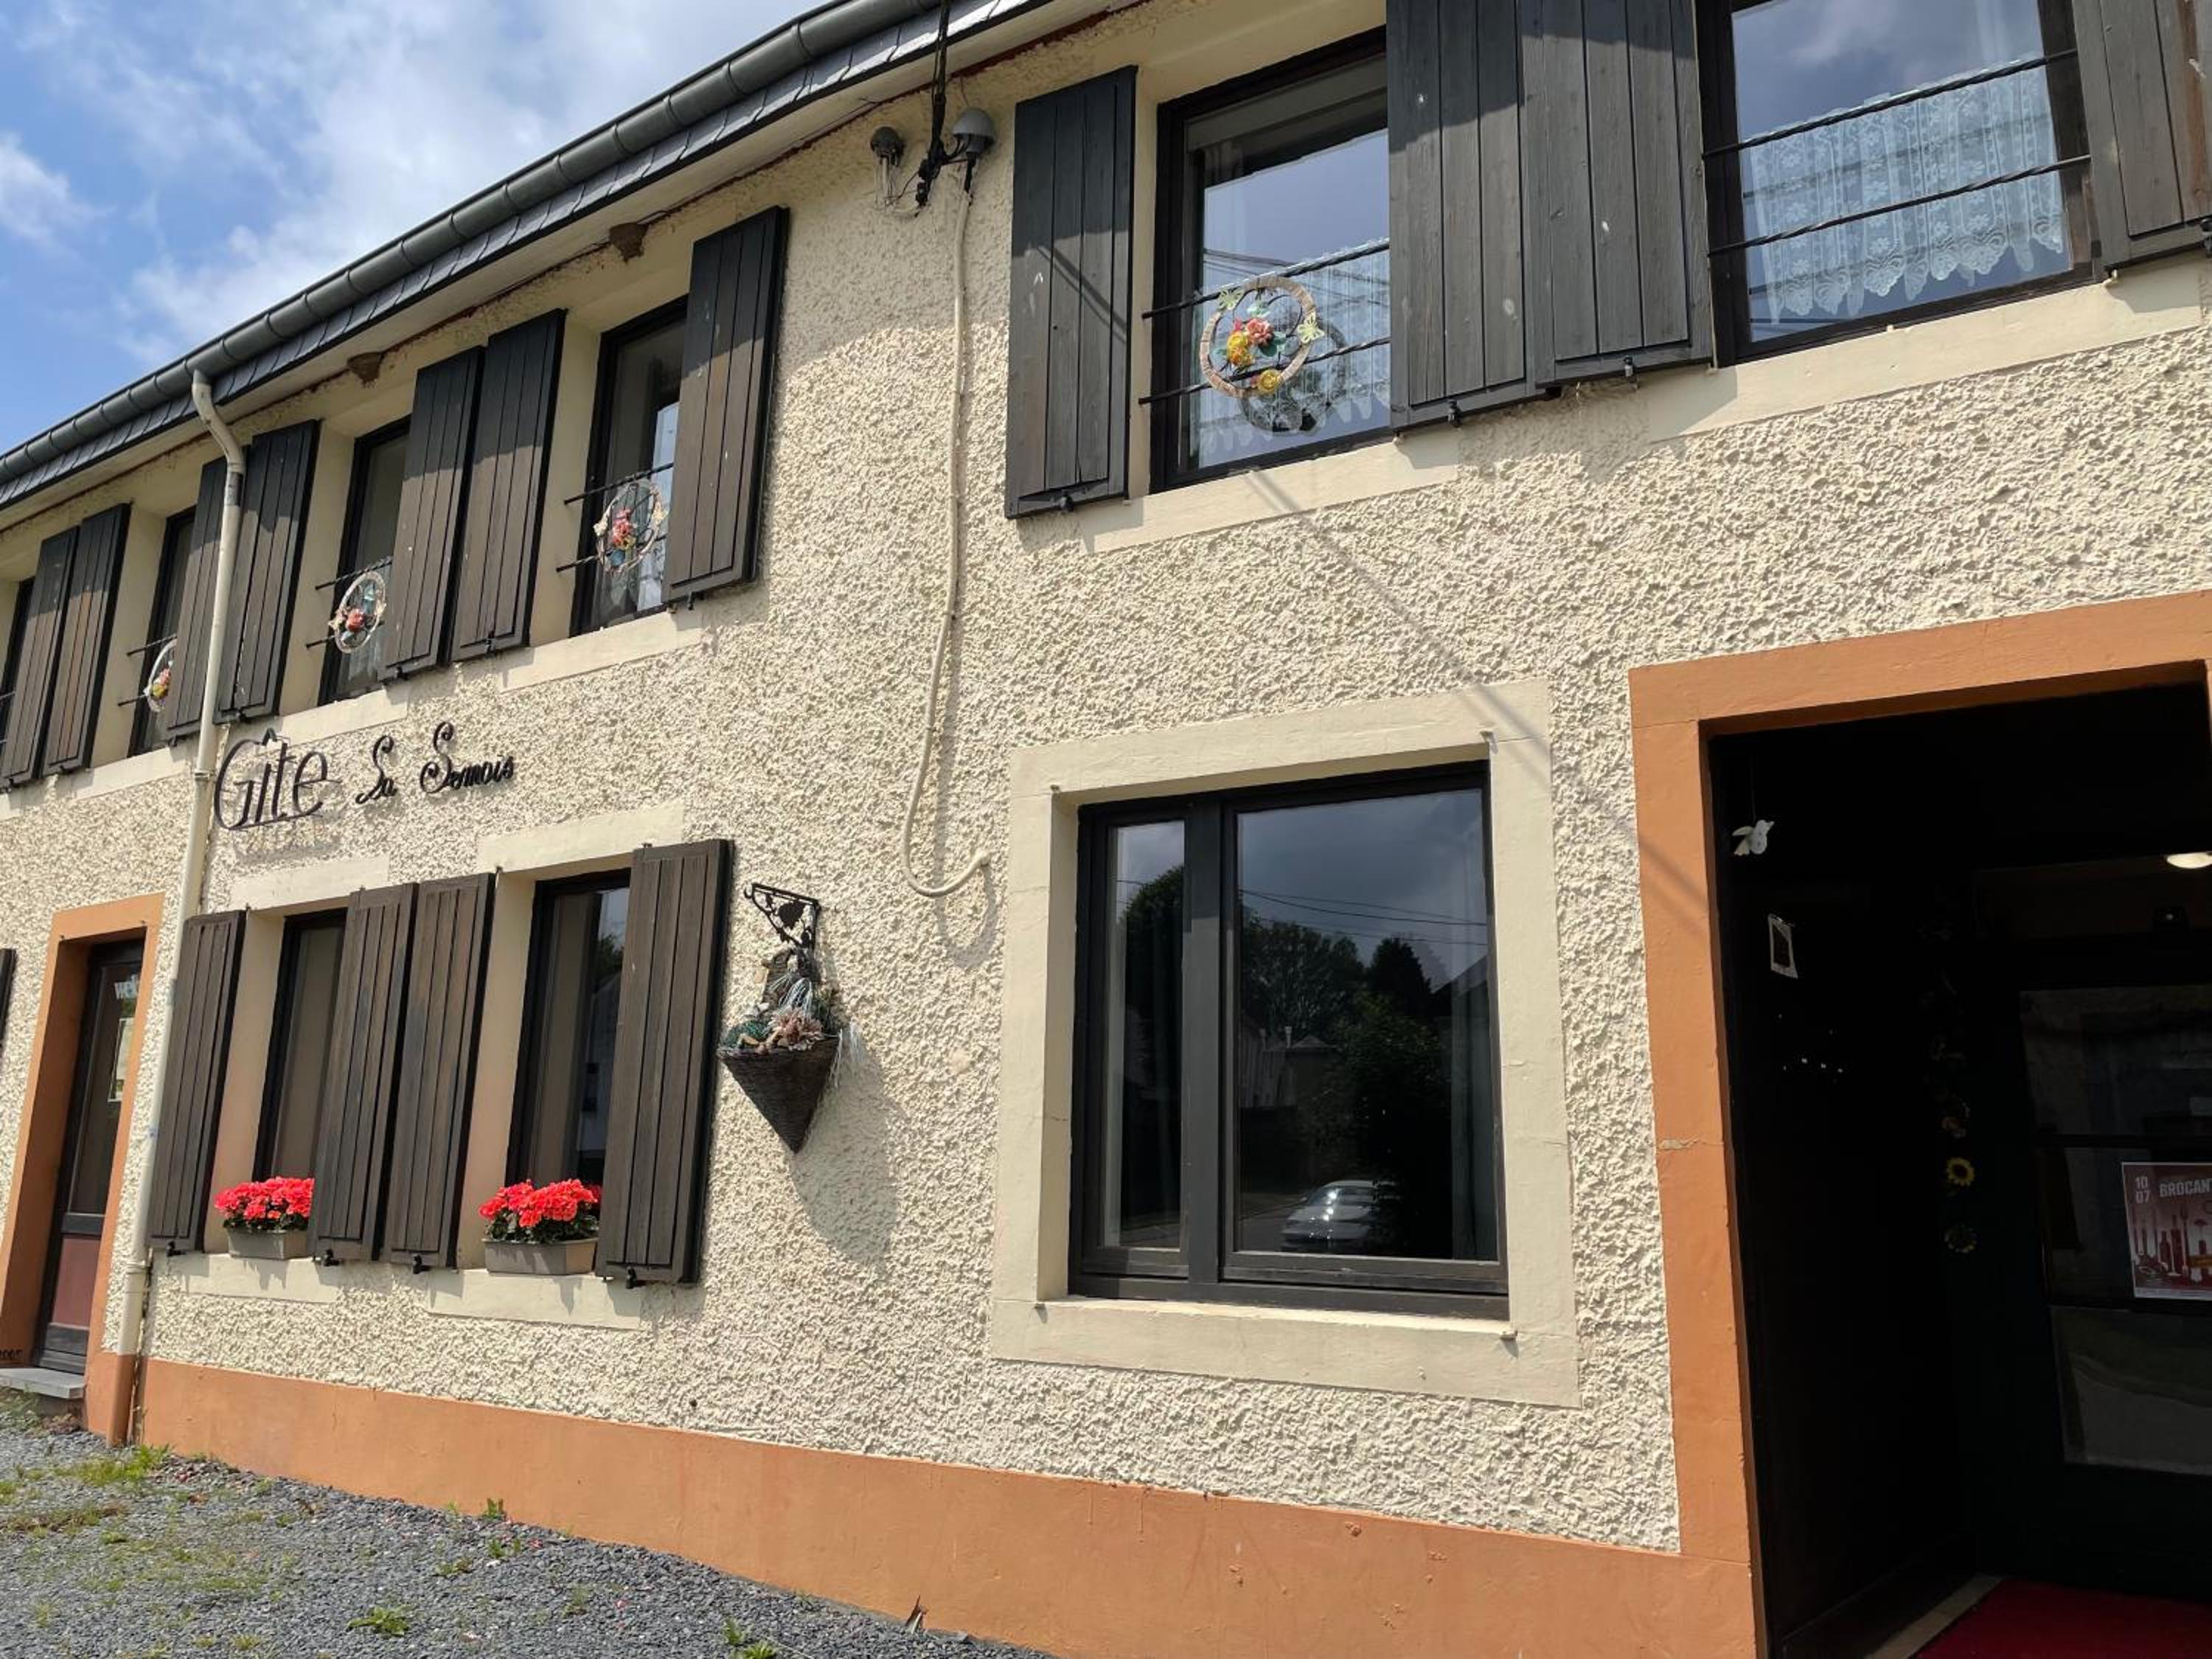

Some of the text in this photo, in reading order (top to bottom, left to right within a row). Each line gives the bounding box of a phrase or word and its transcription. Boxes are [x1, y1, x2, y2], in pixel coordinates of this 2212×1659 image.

[355, 735, 398, 804] La
[420, 721, 515, 794] Semois
[2135, 1176, 2148, 1189] 10
[2135, 1189, 2150, 1203] 07
